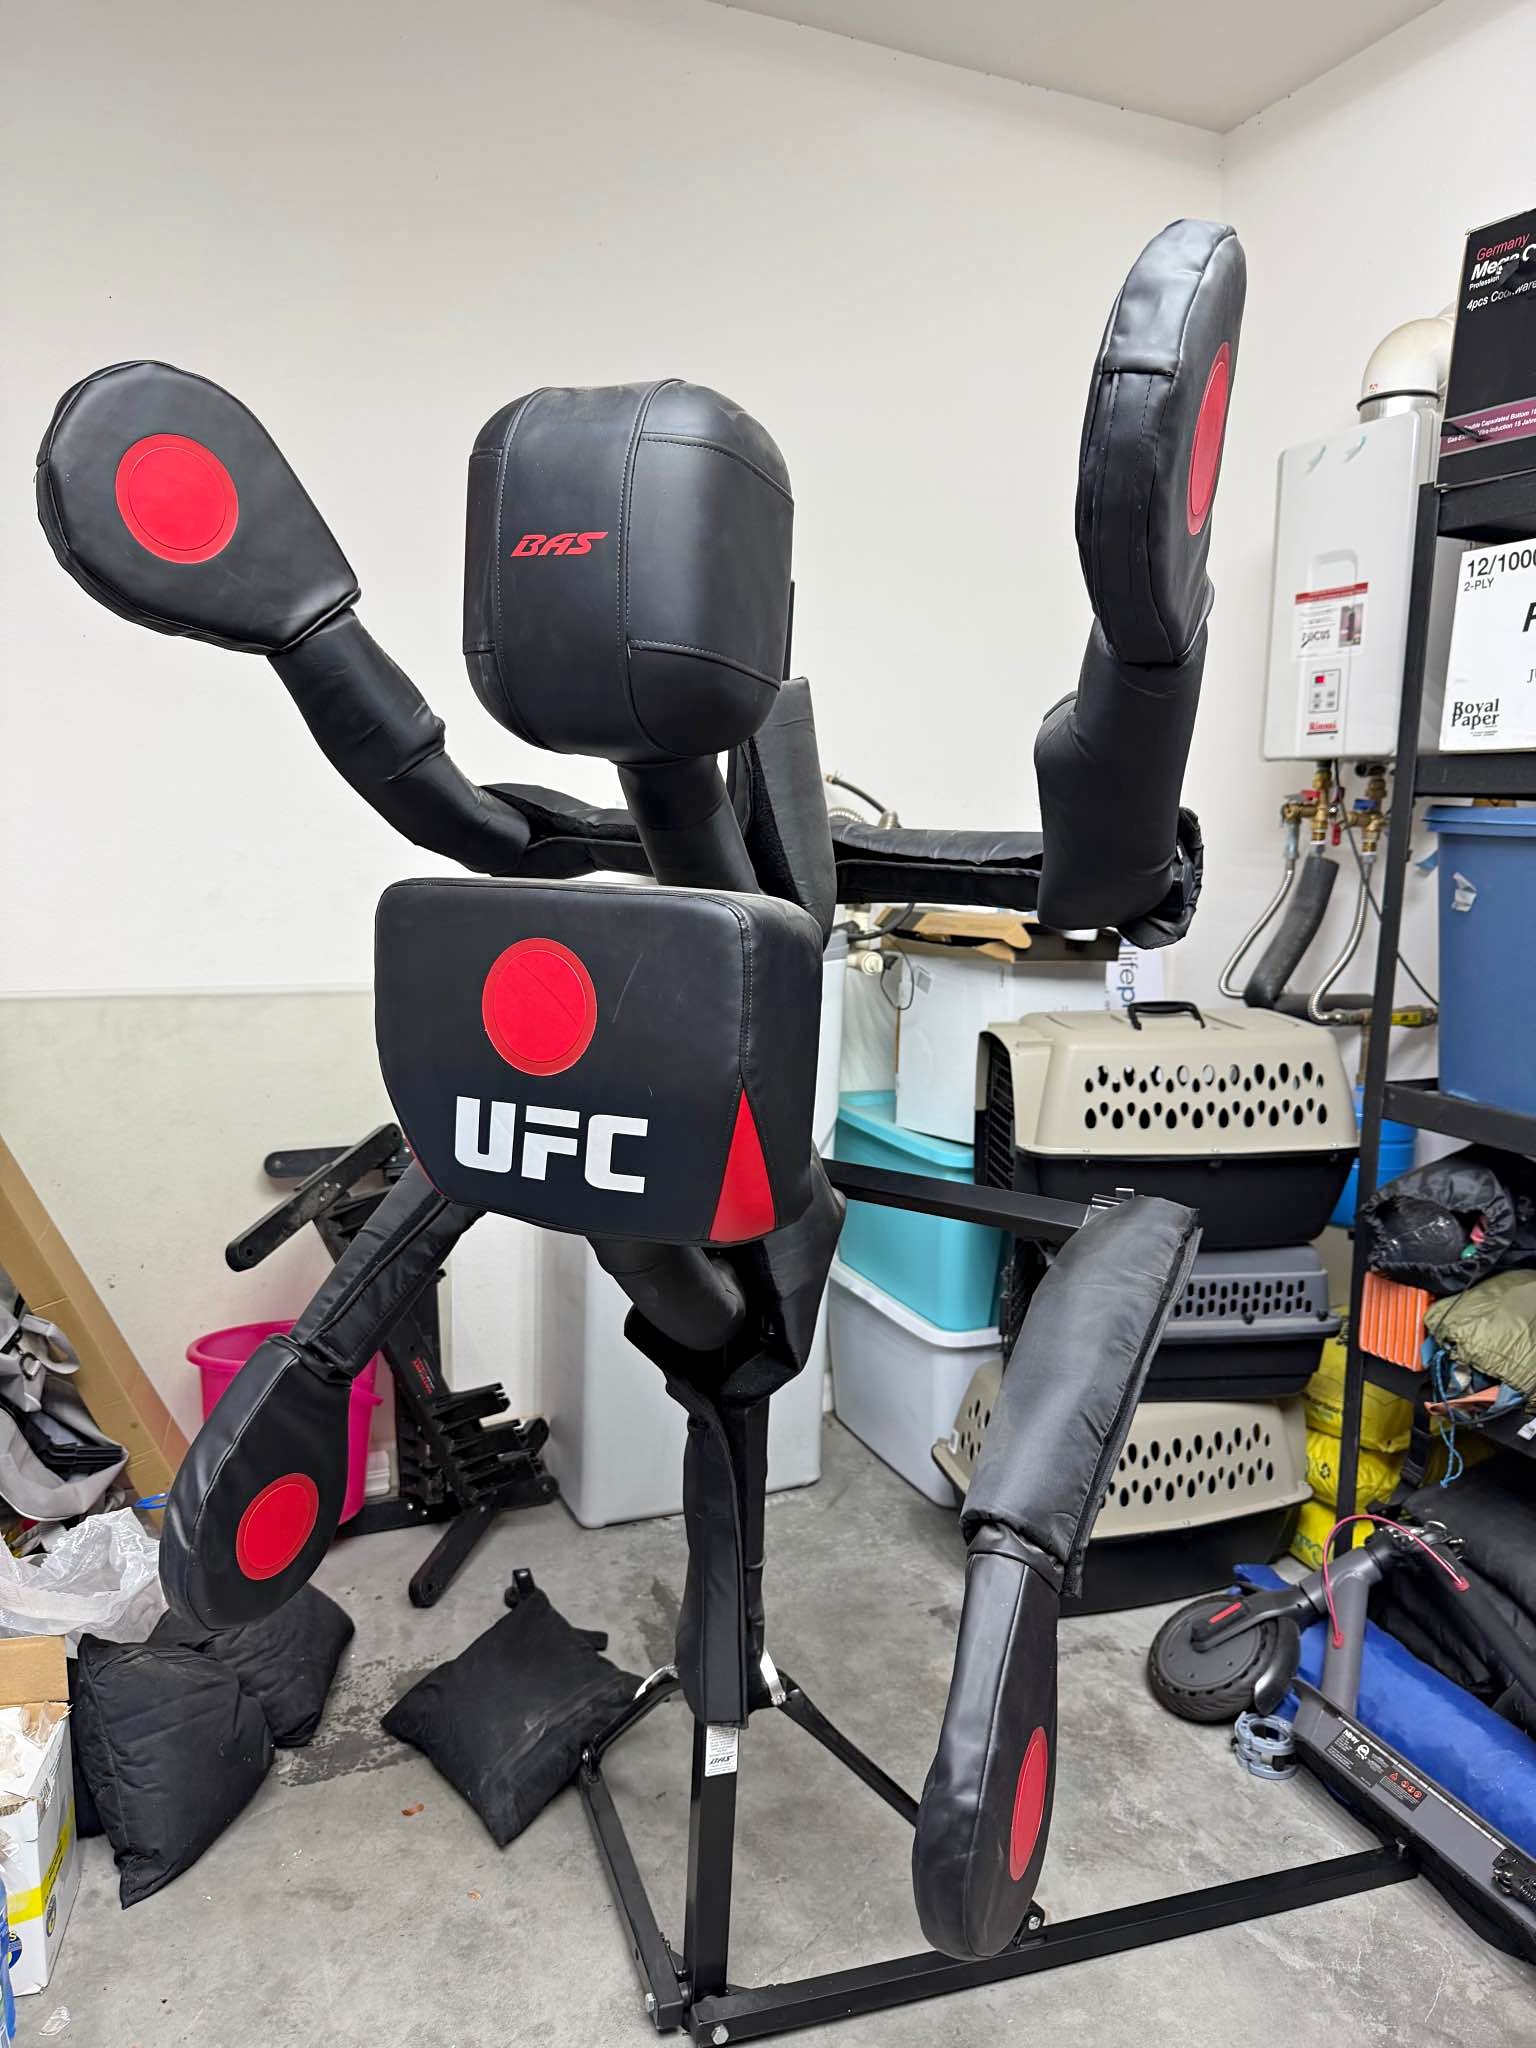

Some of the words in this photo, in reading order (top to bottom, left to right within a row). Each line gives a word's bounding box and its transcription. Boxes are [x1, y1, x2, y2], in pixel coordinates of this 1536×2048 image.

[1476, 233, 1531, 261] Germany
[1467, 296, 1489, 311] 4pcs
[1490, 279, 1536, 303] Cooware
[511, 531, 608, 557] BAS
[1464, 577, 1495, 592] 2-PLY
[1453, 698, 1500, 716] Royal
[1451, 713, 1501, 730] Paper
[455, 1096, 648, 1193] UFC
